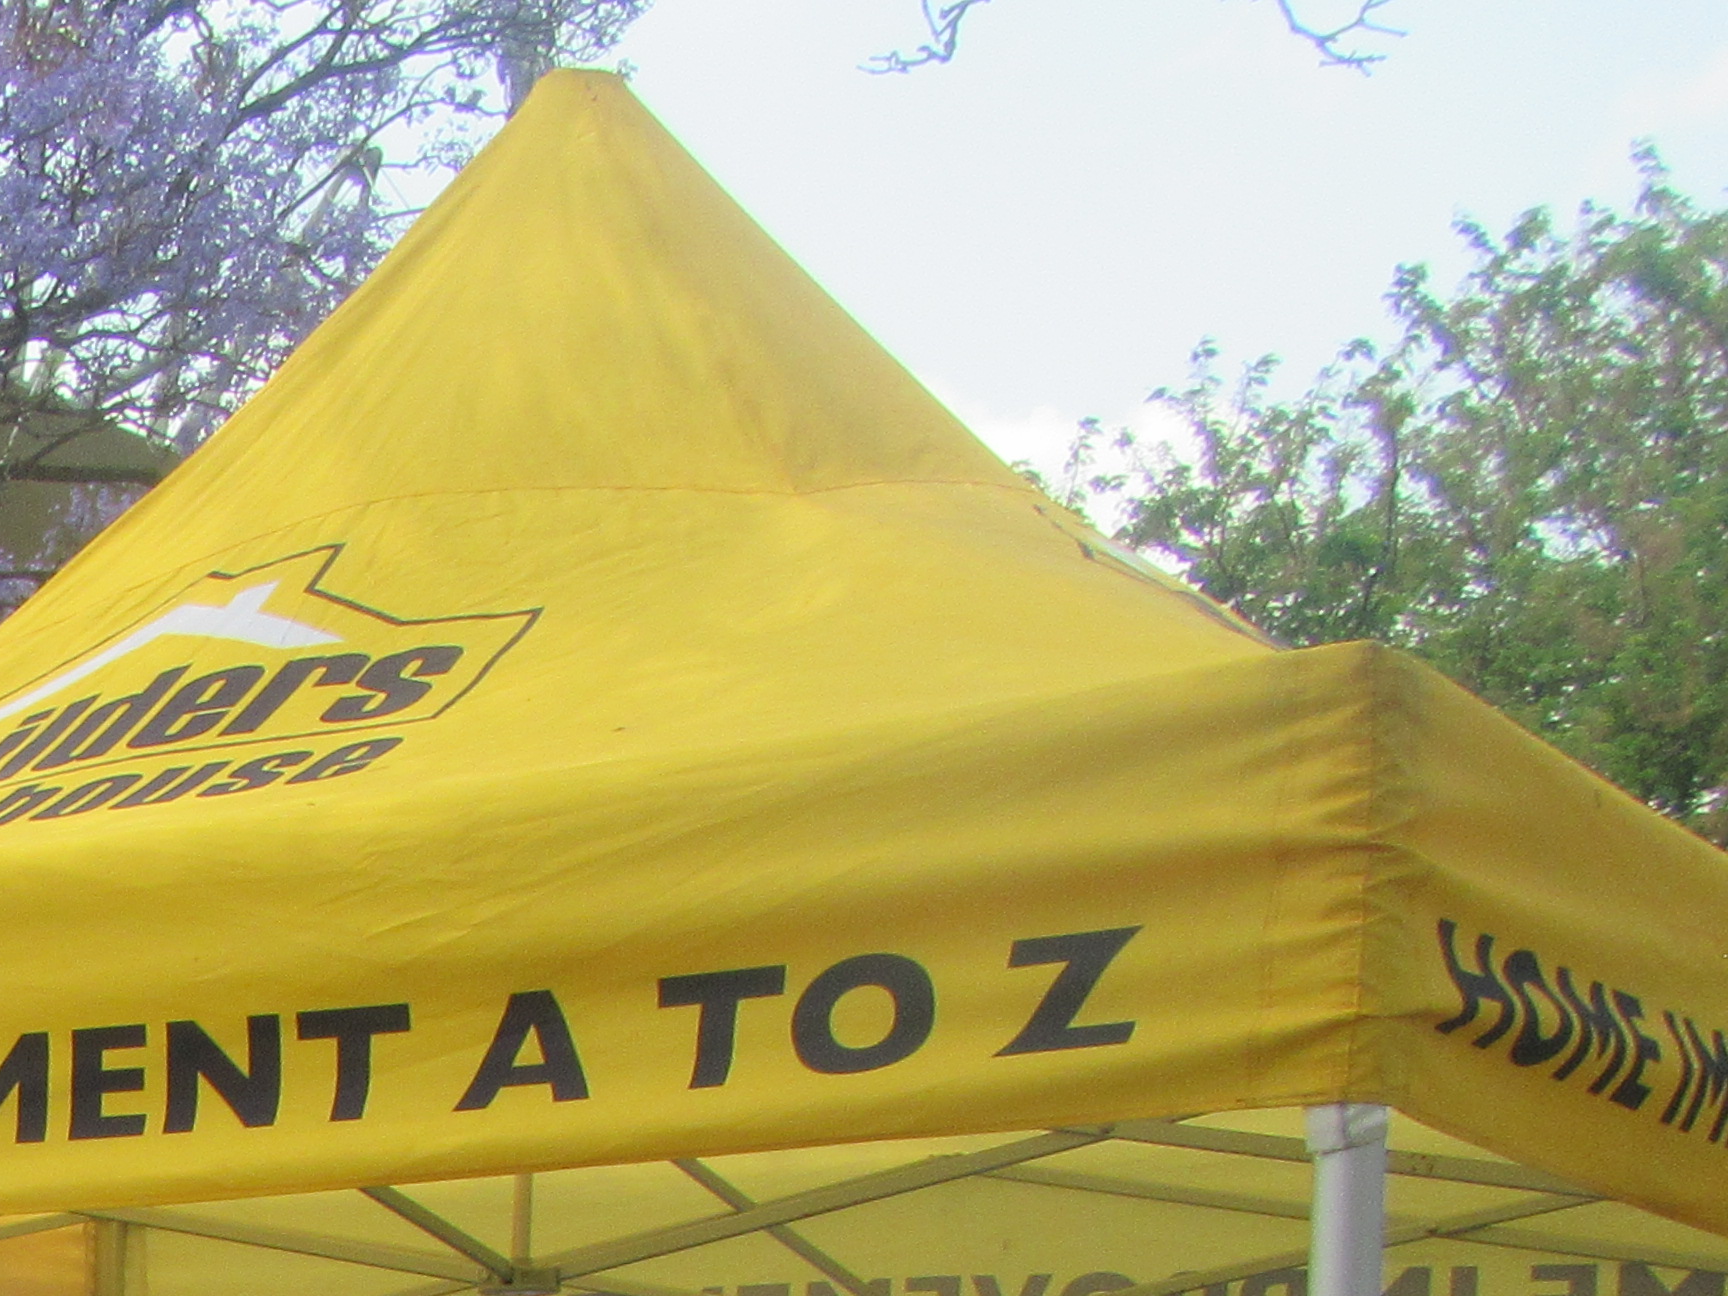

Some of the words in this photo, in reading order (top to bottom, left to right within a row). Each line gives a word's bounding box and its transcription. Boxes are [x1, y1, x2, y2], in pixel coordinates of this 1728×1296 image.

[456, 990, 590, 1112] A
[657, 952, 937, 1090] TO
[992, 925, 1144, 1059] Z
[1434, 918, 1661, 1110] HOME
